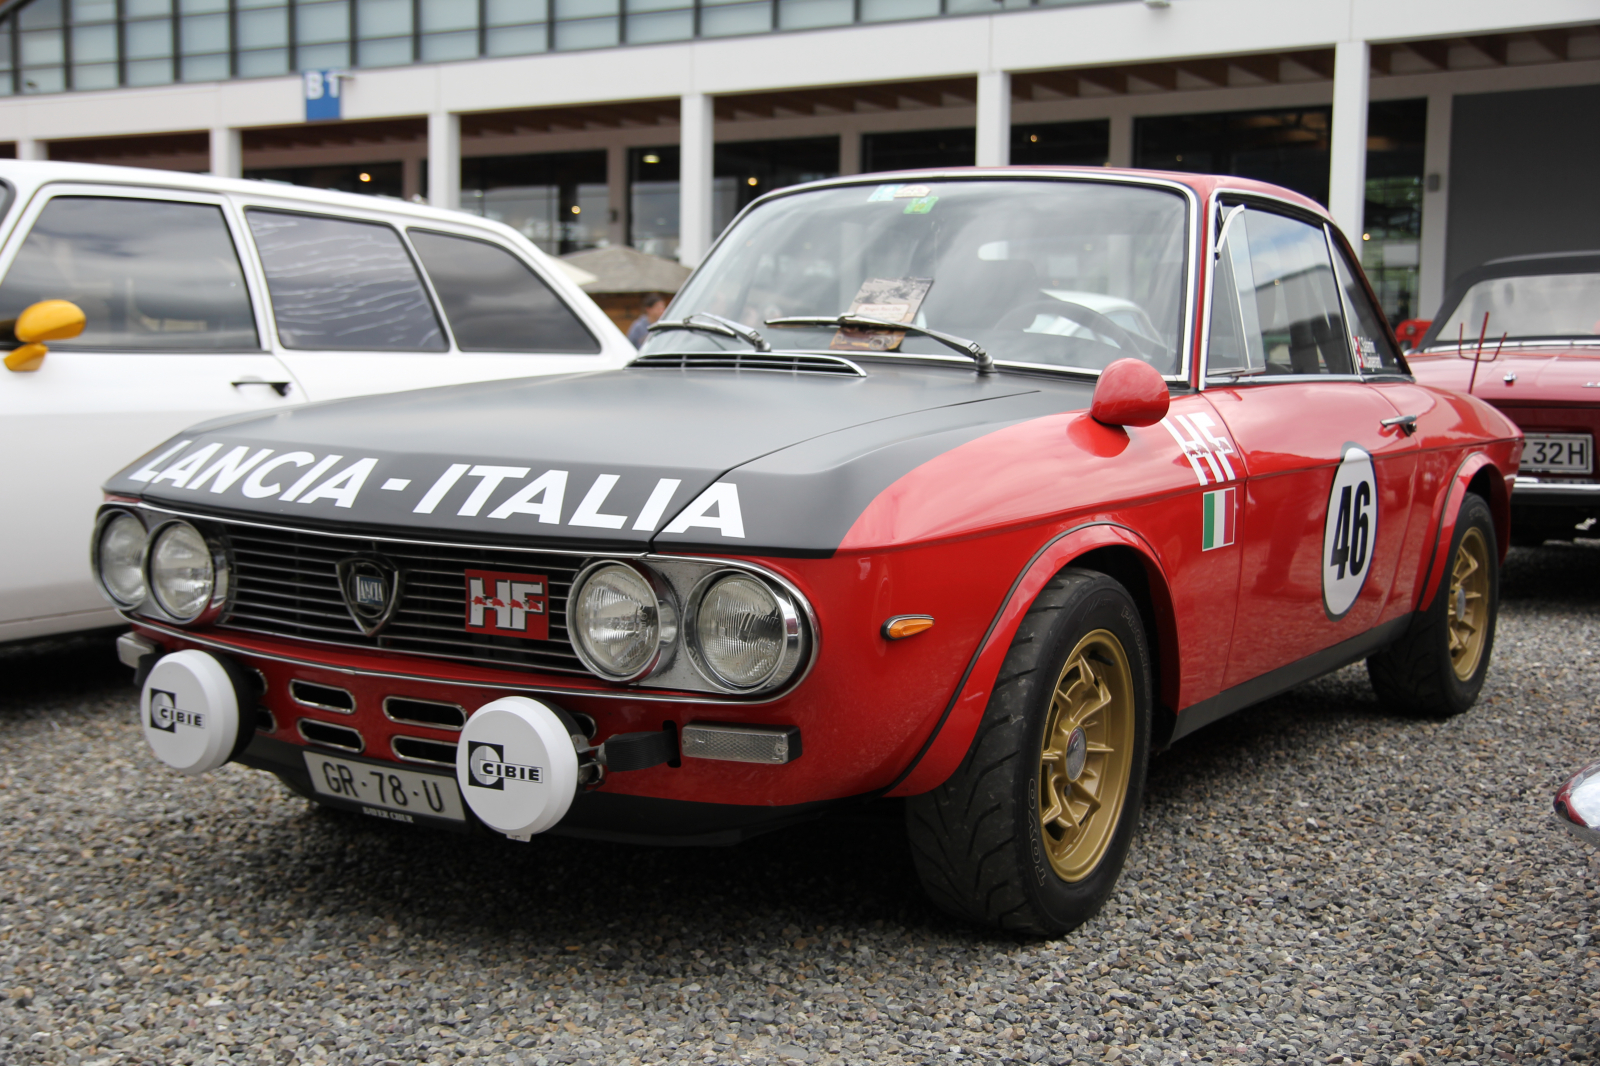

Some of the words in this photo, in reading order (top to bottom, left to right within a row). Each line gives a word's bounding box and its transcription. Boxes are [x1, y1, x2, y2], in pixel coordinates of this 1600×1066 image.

[305, 71, 340, 99] B1
[1160, 412, 1236, 486] HF
[128, 440, 379, 508] LANCIA
[412, 463, 746, 538] ITALIA
[1330, 480, 1370, 581] 46
[356, 576, 384, 603] LANCIA
[468, 577, 544, 632] HF
[1028, 778, 1046, 886] TOYO
